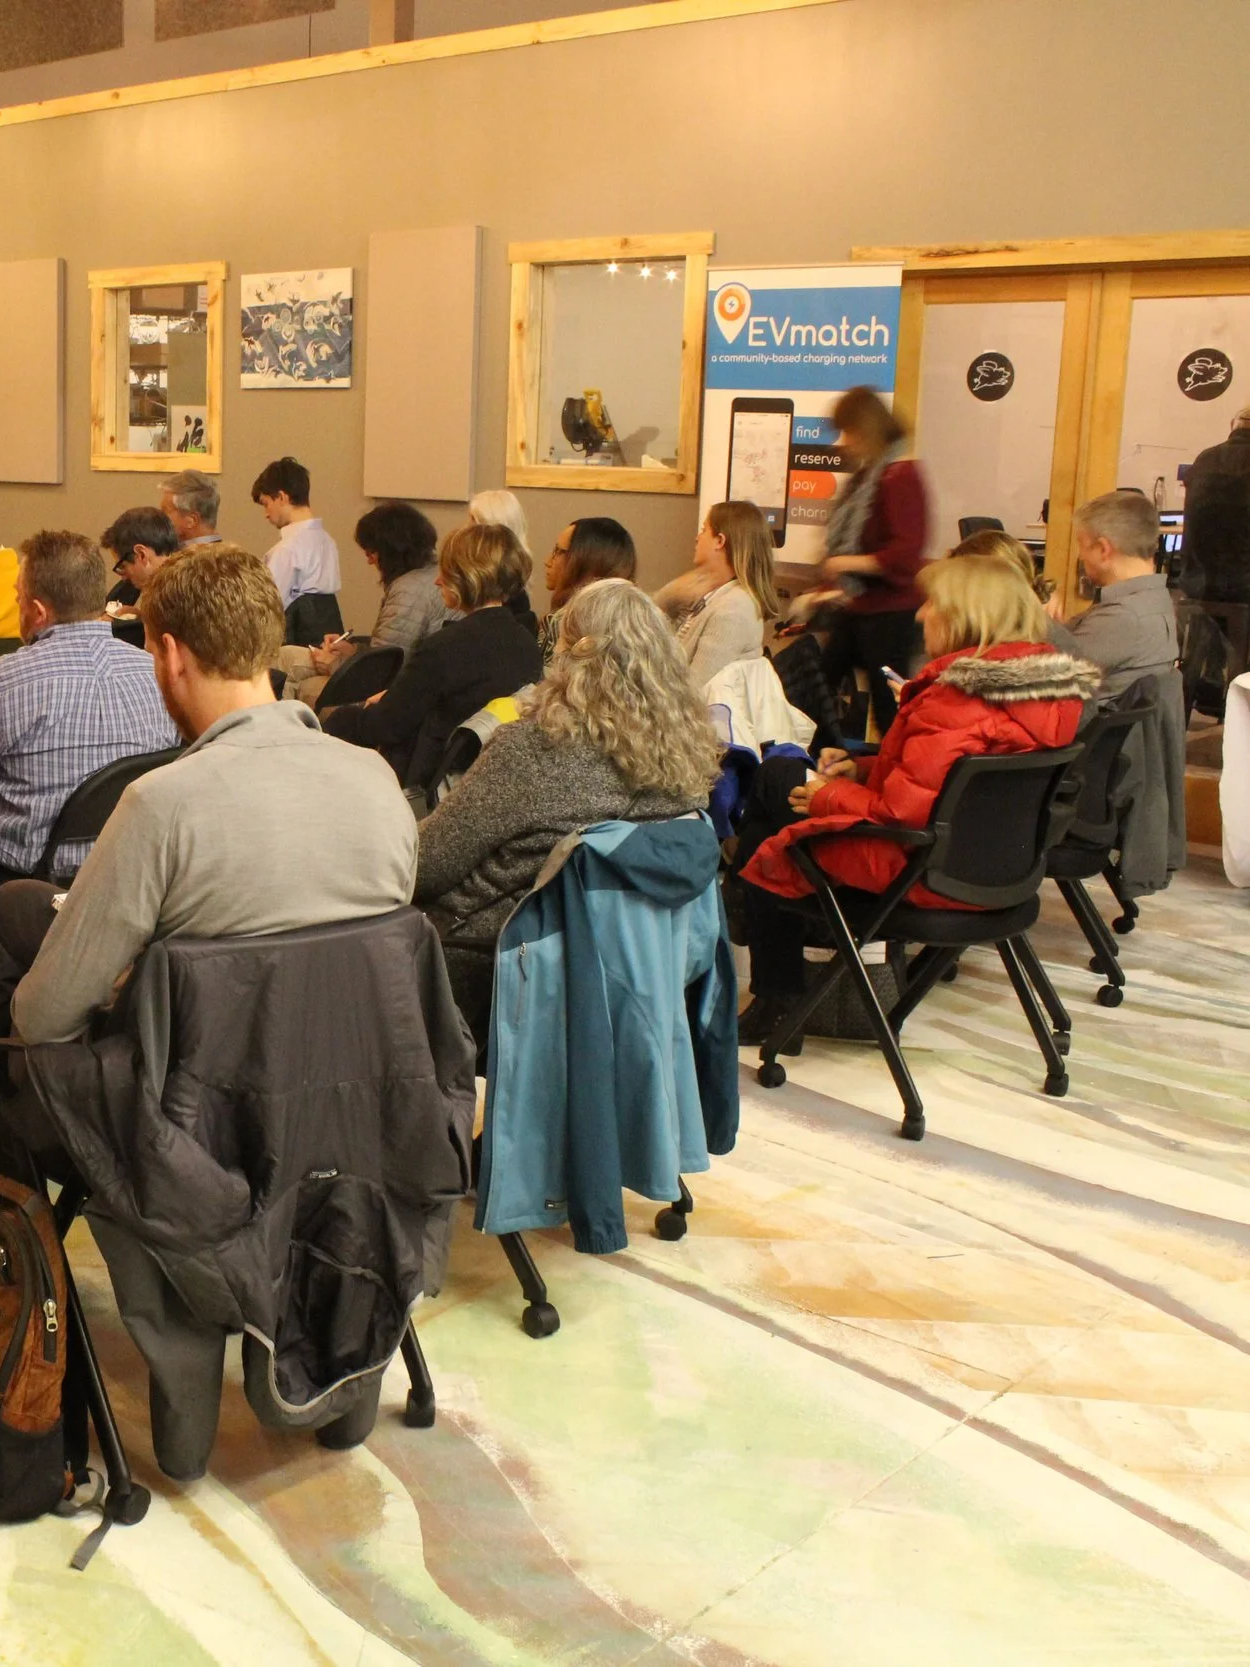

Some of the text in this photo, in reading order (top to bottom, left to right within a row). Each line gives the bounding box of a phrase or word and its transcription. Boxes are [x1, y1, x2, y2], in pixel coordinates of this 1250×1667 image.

[748, 315, 889, 347] EVmatch
[711, 353, 888, 366] a community-based charging network
[796, 425, 820, 438] find
[794, 453, 841, 465] reserve
[792, 480, 817, 494] pay
[790, 505, 827, 520] charg
